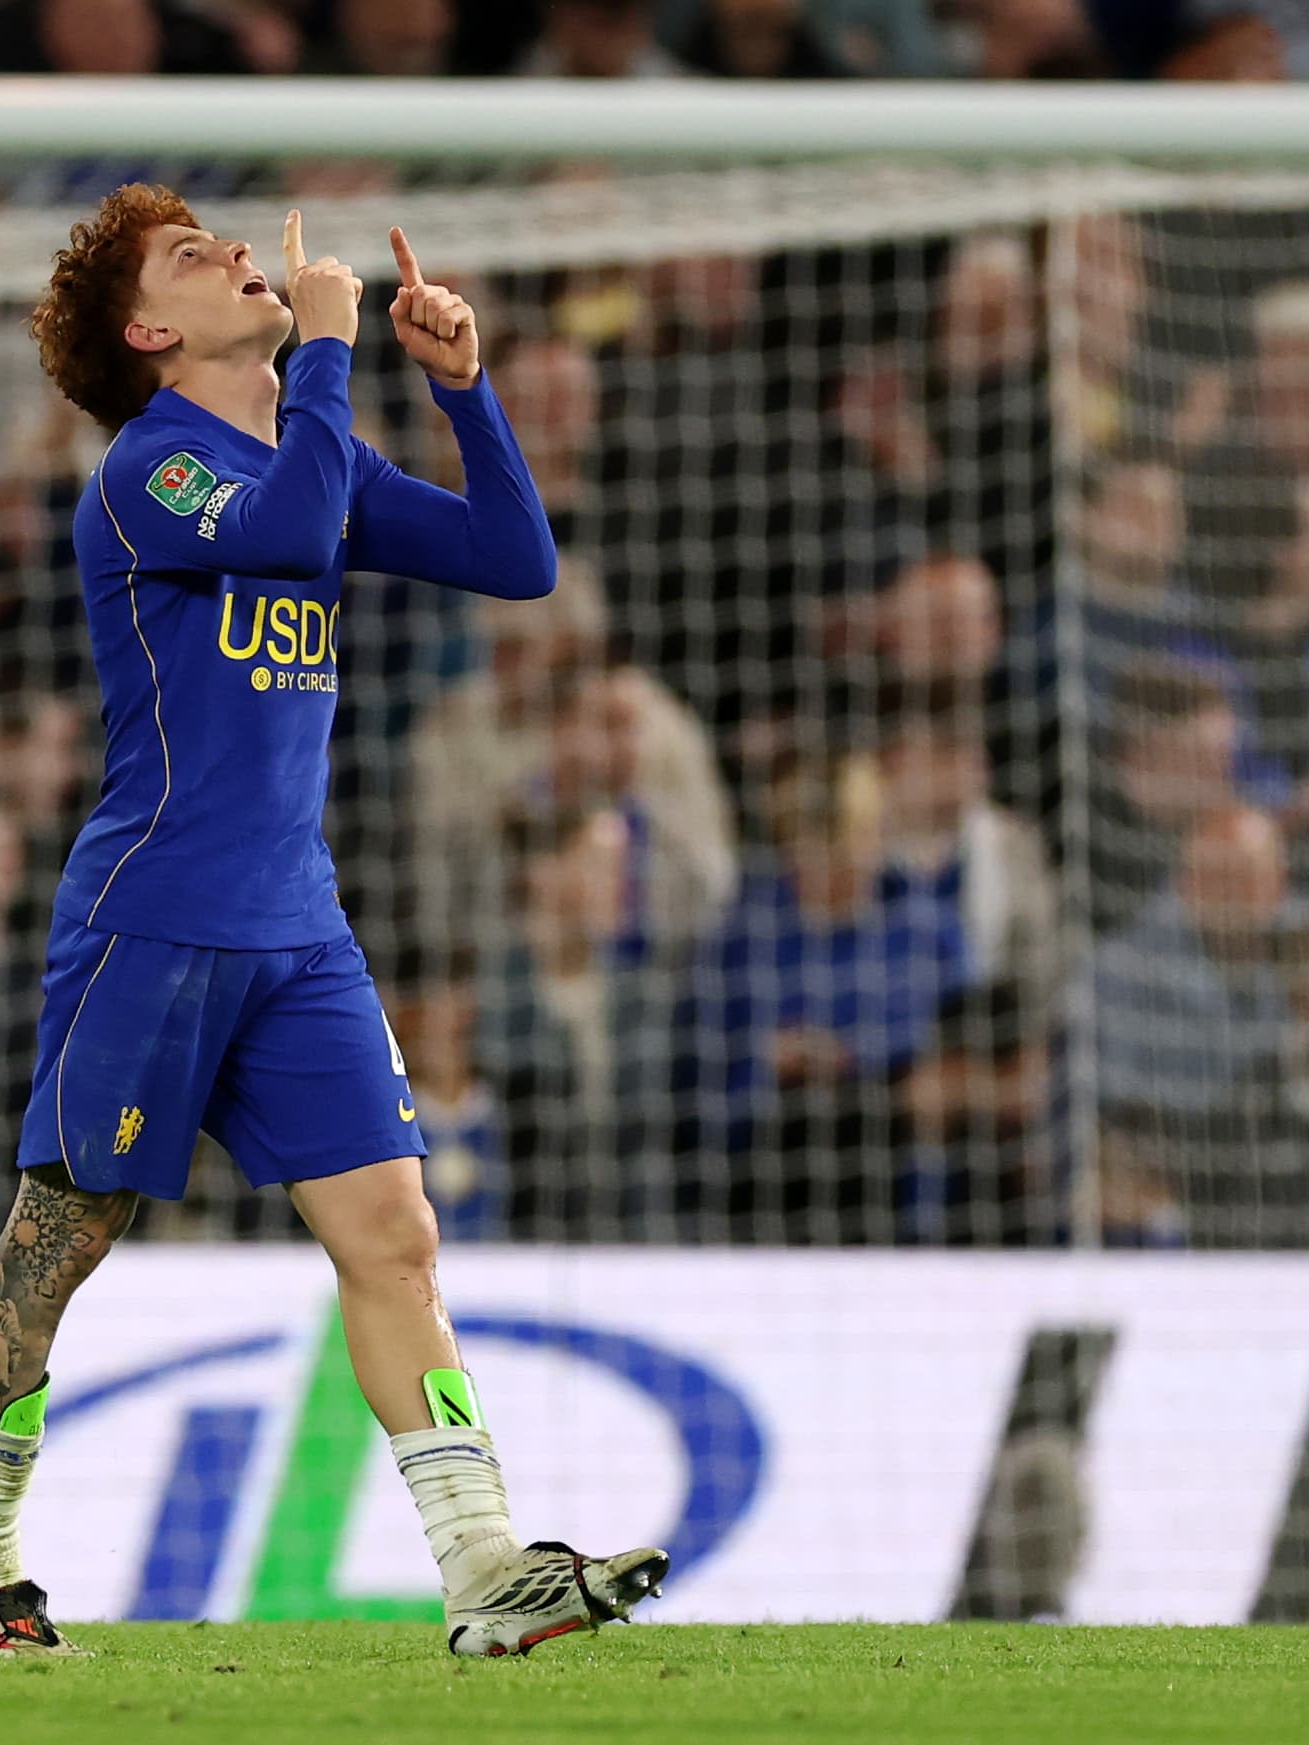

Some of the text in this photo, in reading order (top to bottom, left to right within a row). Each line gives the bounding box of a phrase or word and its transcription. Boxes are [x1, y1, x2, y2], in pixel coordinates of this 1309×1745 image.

[197, 483, 232, 537] No room
[202, 482, 244, 541] for racism
[276, 671, 337, 692] BY CIRCLE
